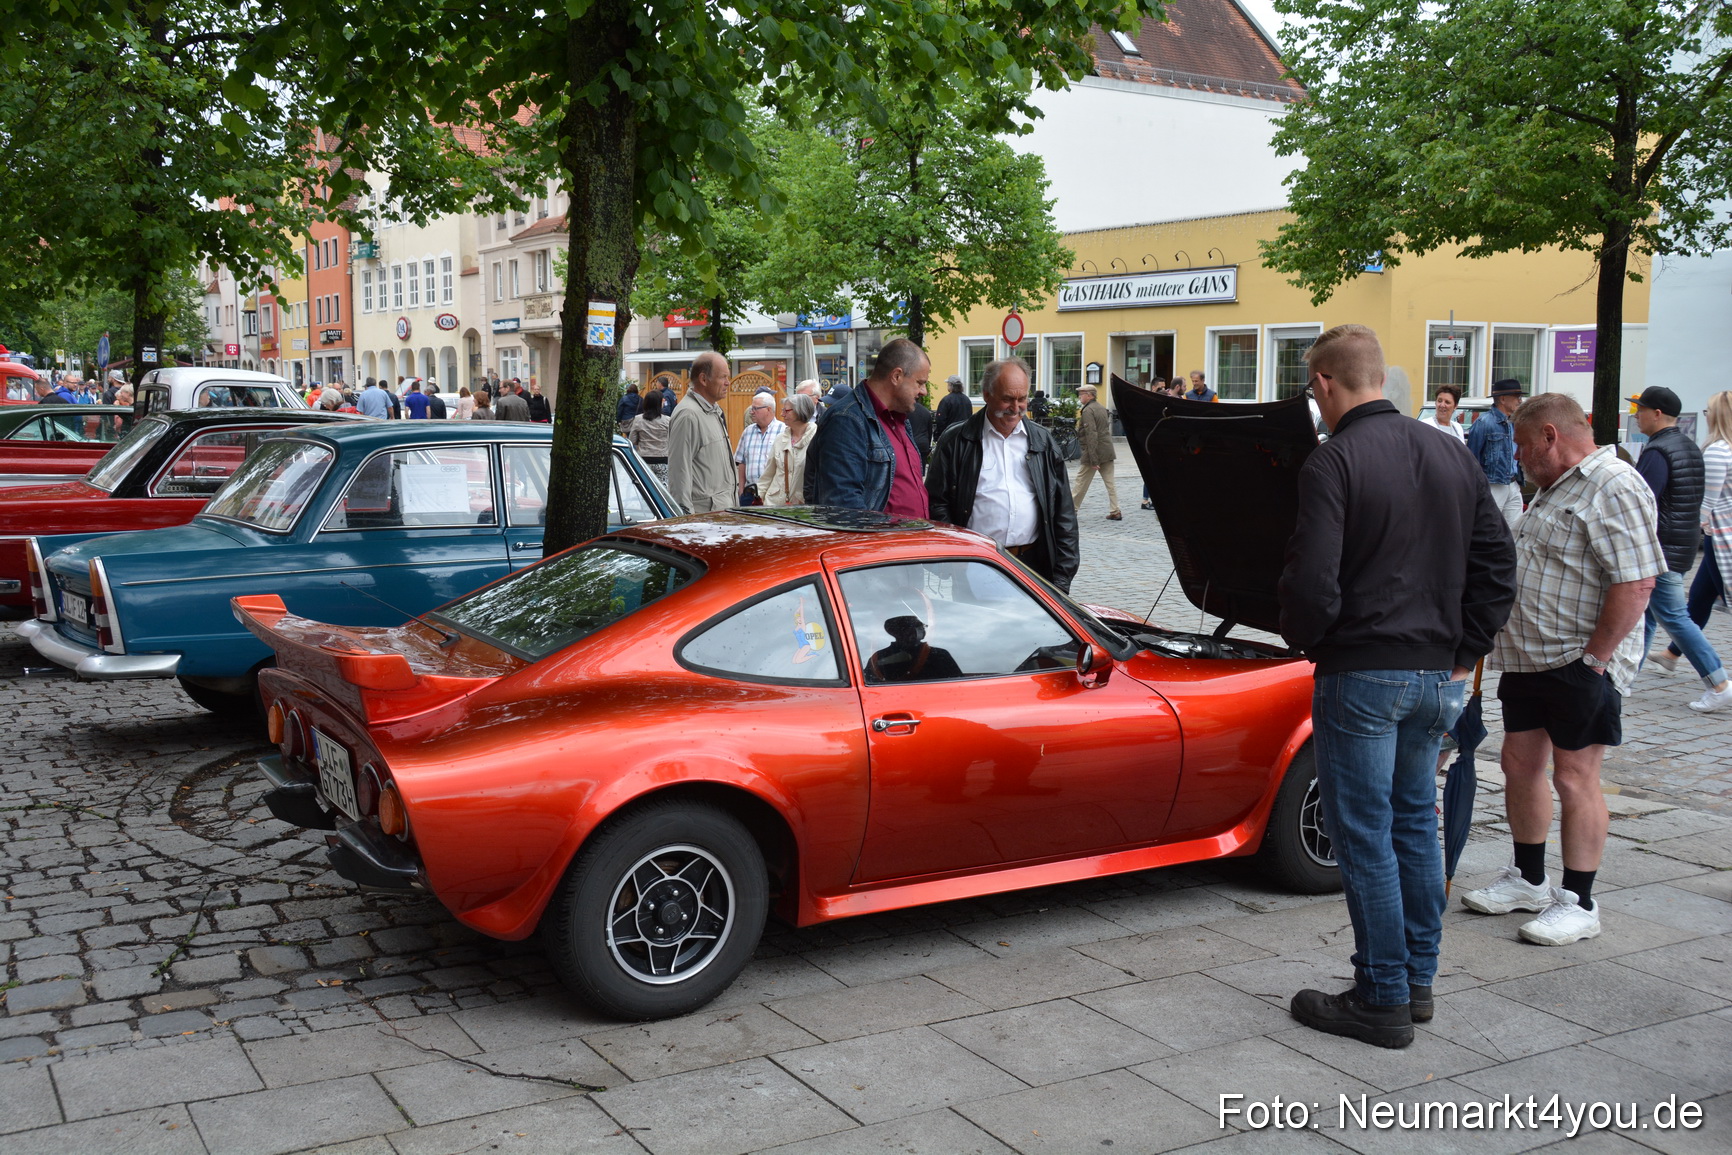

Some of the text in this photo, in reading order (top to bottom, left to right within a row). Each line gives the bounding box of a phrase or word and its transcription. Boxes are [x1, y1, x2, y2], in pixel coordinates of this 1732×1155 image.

[1063, 275, 1230, 303] GASTHAUS mittlere GANS
[805, 632, 824, 640] OPEL
[318, 736, 339, 774] LIF
